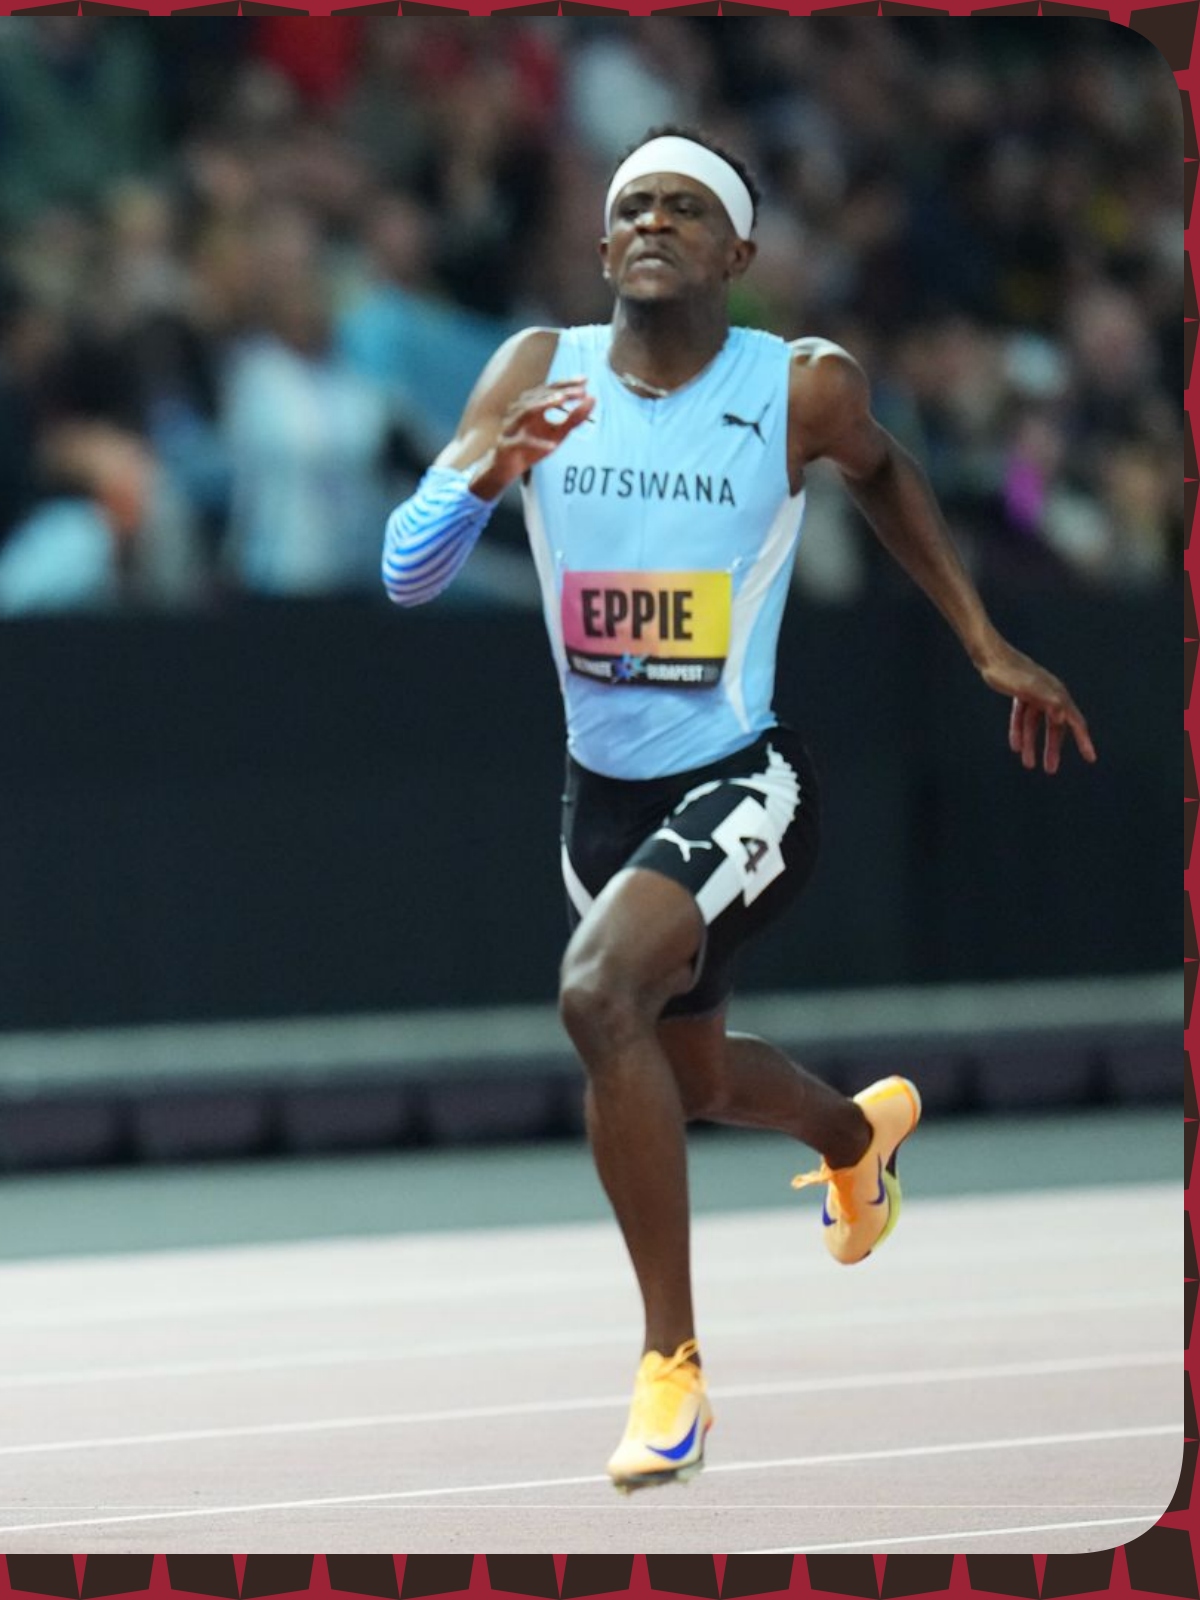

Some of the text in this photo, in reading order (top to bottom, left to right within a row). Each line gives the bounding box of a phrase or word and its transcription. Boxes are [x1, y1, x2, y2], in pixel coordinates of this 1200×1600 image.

[563, 465, 736, 507] BOTSWANA
[581, 589, 693, 640] EPPIE
[739, 836, 769, 875] 4
